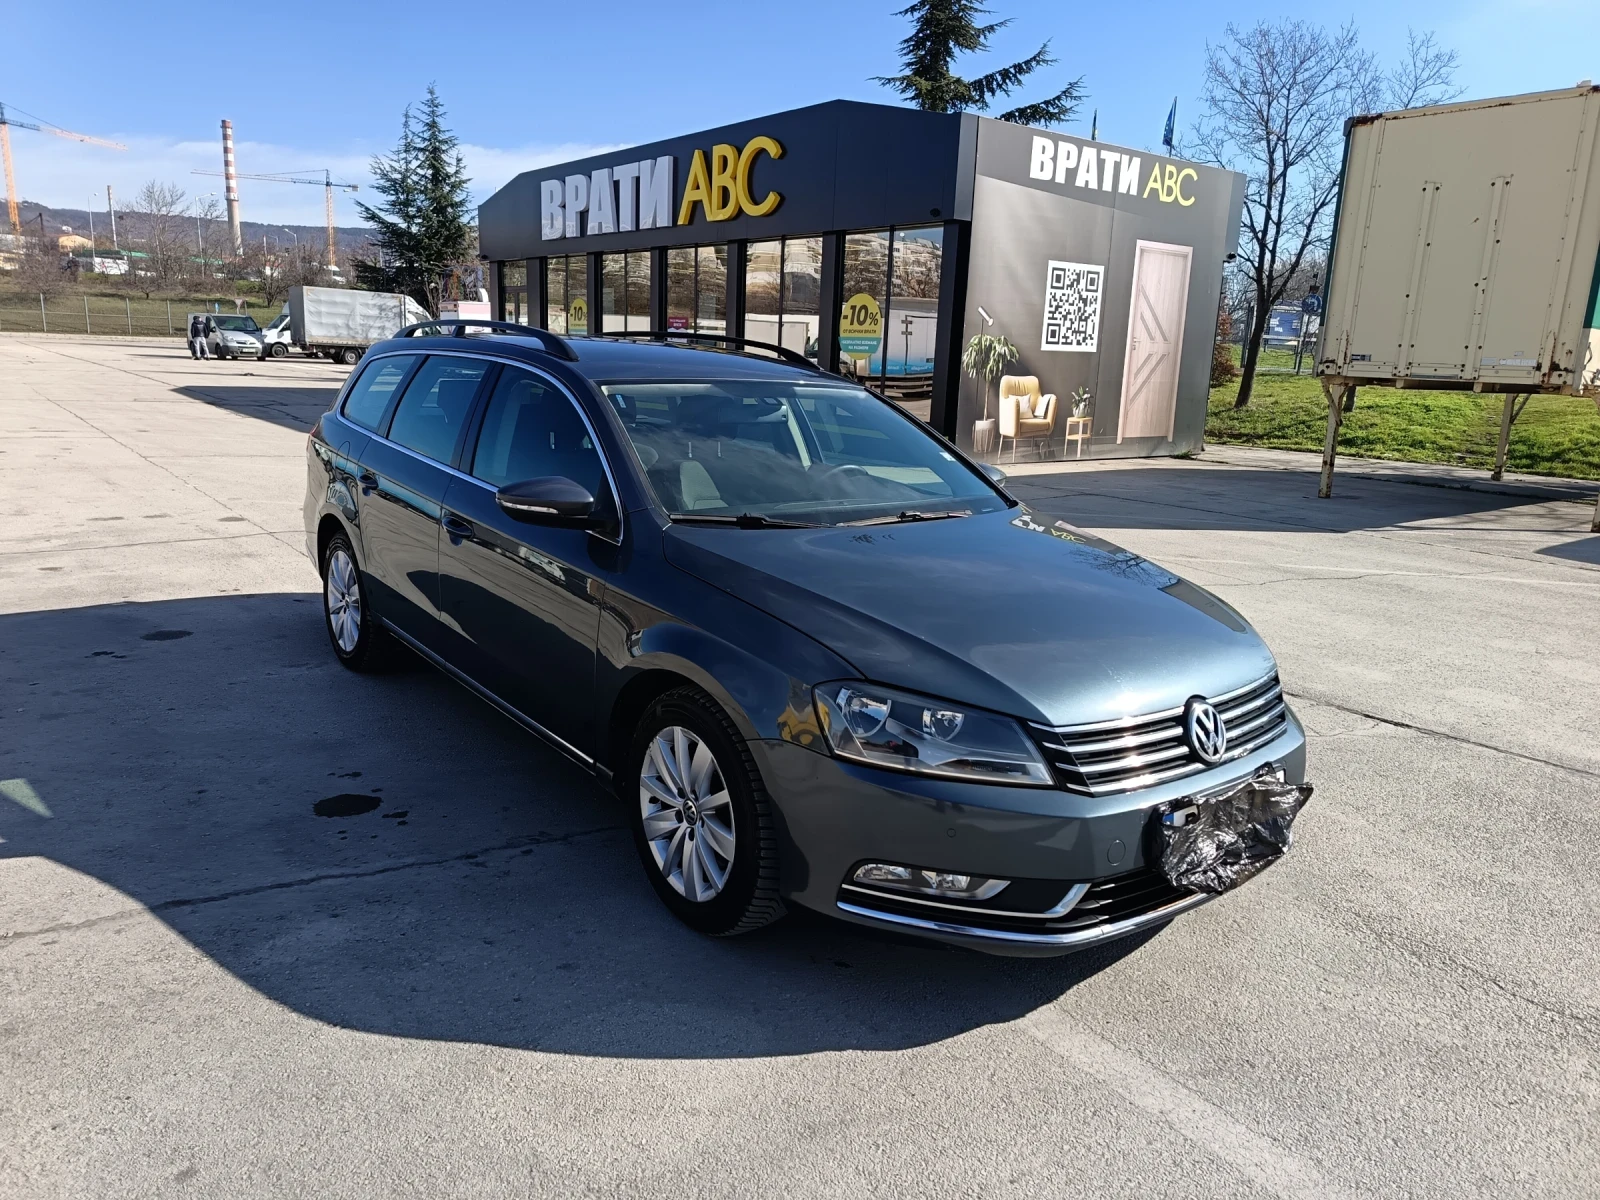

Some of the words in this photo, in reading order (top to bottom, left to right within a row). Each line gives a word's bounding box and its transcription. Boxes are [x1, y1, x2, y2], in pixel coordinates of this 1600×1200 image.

[541, 155, 674, 241] ВРАТИ
[678, 136, 783, 225] ABC
[1029, 135, 1141, 196] ВРАТИ
[1143, 162, 1198, 206] ABC
[843, 304, 878, 326] -10%
